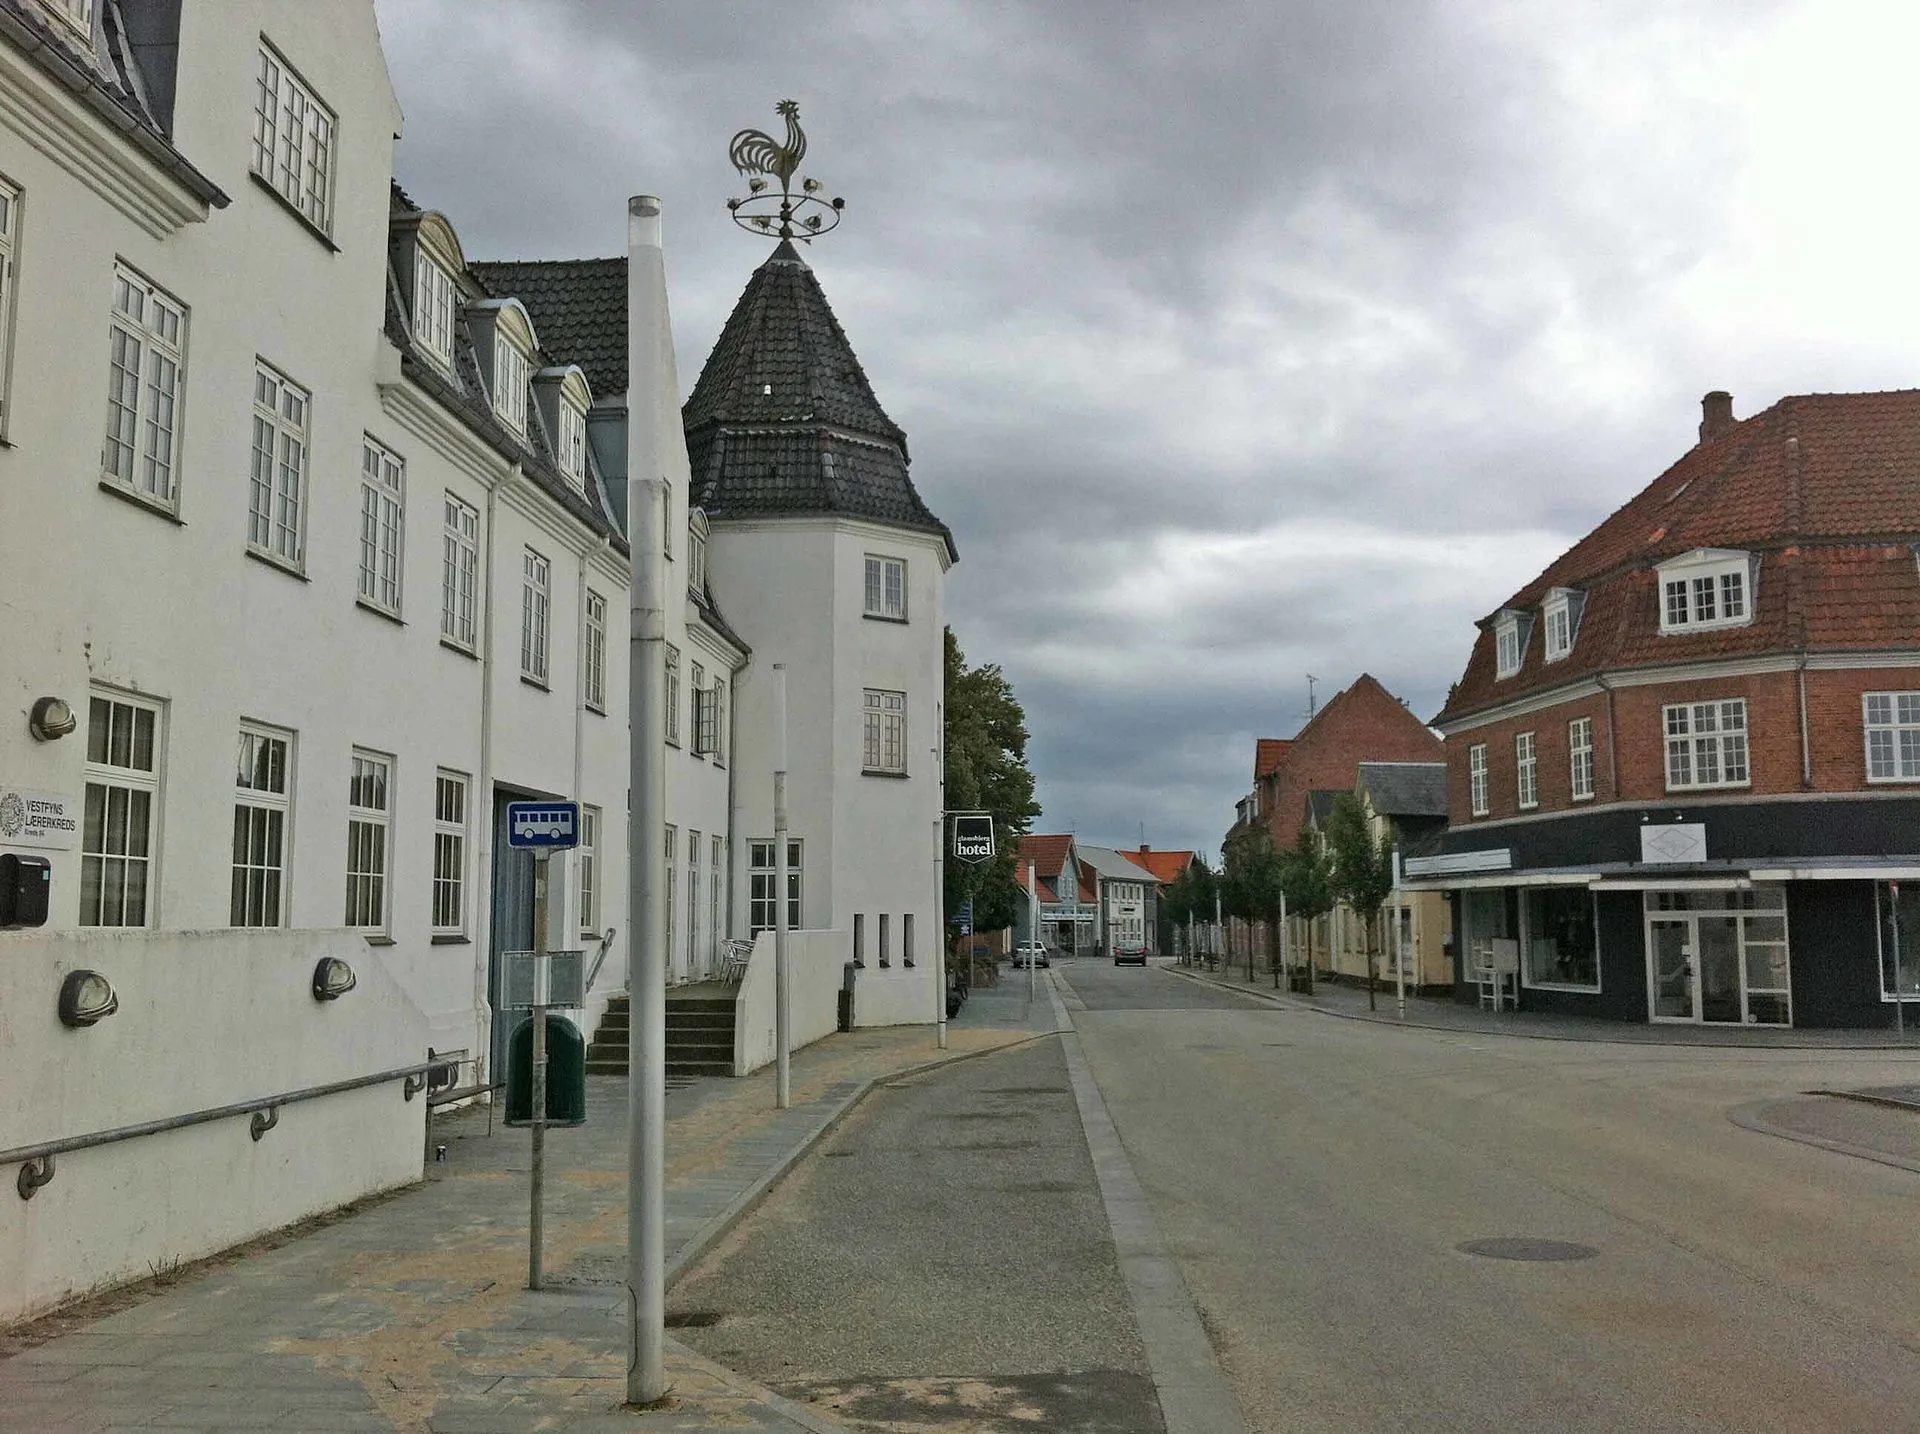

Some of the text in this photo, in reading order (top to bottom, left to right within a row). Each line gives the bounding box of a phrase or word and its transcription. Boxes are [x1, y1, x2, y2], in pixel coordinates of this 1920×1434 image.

[27, 800, 63, 815] VESTFYNS
[26, 815, 75, 831] LÆRERKREDS
[957, 842, 991, 855] hotel
